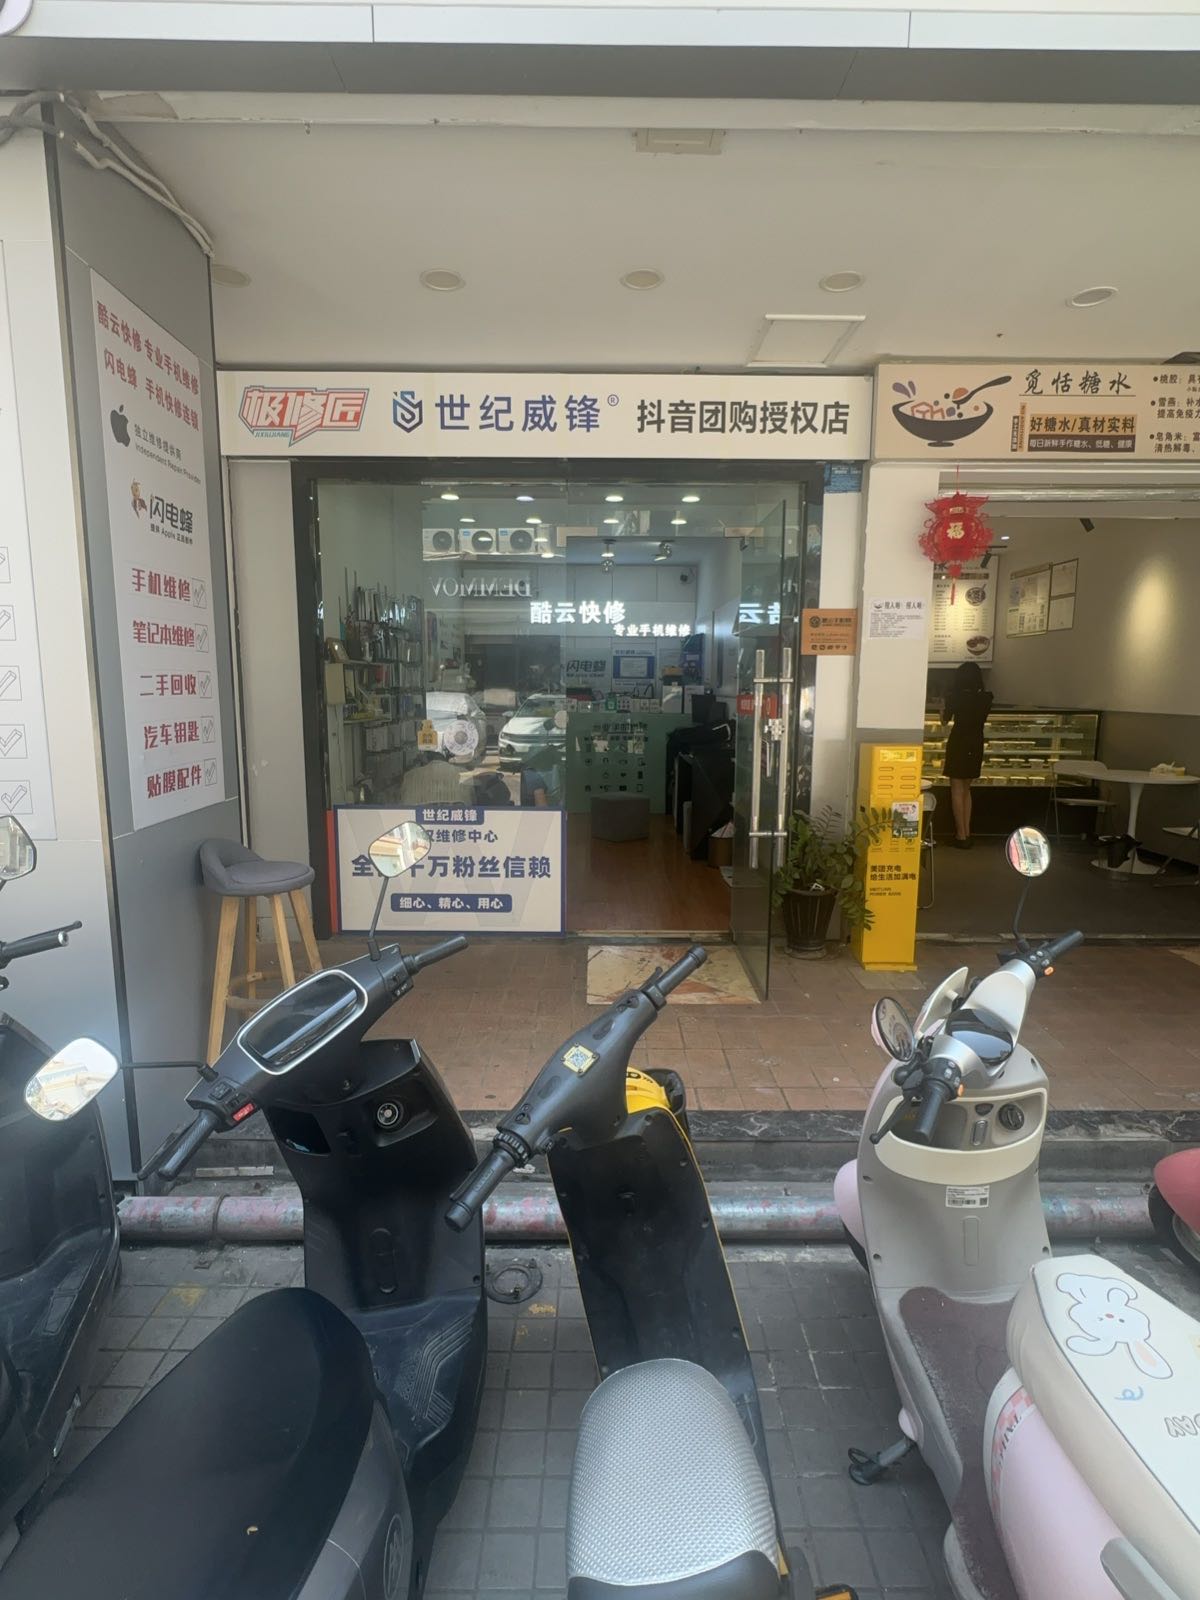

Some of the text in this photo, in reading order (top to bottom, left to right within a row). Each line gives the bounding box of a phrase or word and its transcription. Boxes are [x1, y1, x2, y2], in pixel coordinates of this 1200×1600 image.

[97, 301, 199, 395] 酷云快修 专业手机维修
[104, 348, 138, 389] 闪电蜂
[242, 389, 367, 440] 极修匠
[435, 394, 600, 432] 世纪威锋
[637, 399, 850, 434] 抖音团购授权店
[1030, 416, 1135, 433] 好糖水/真材实料
[150, 494, 193, 534] 闪电蜂
[131, 567, 192, 602] 手机维修
[530, 601, 626, 624] 酷云快修
[132, 619, 195, 648] 笔记本维修
[613, 623, 692, 638] 专业手机维修
[139, 673, 197, 697] 二手回收
[143, 721, 200, 750] 汽车钥匙
[146, 765, 202, 799] 贴膜配件
[422, 808, 478, 822] 世纪威锋
[399, 896, 504, 910] 细心、精心、用心
